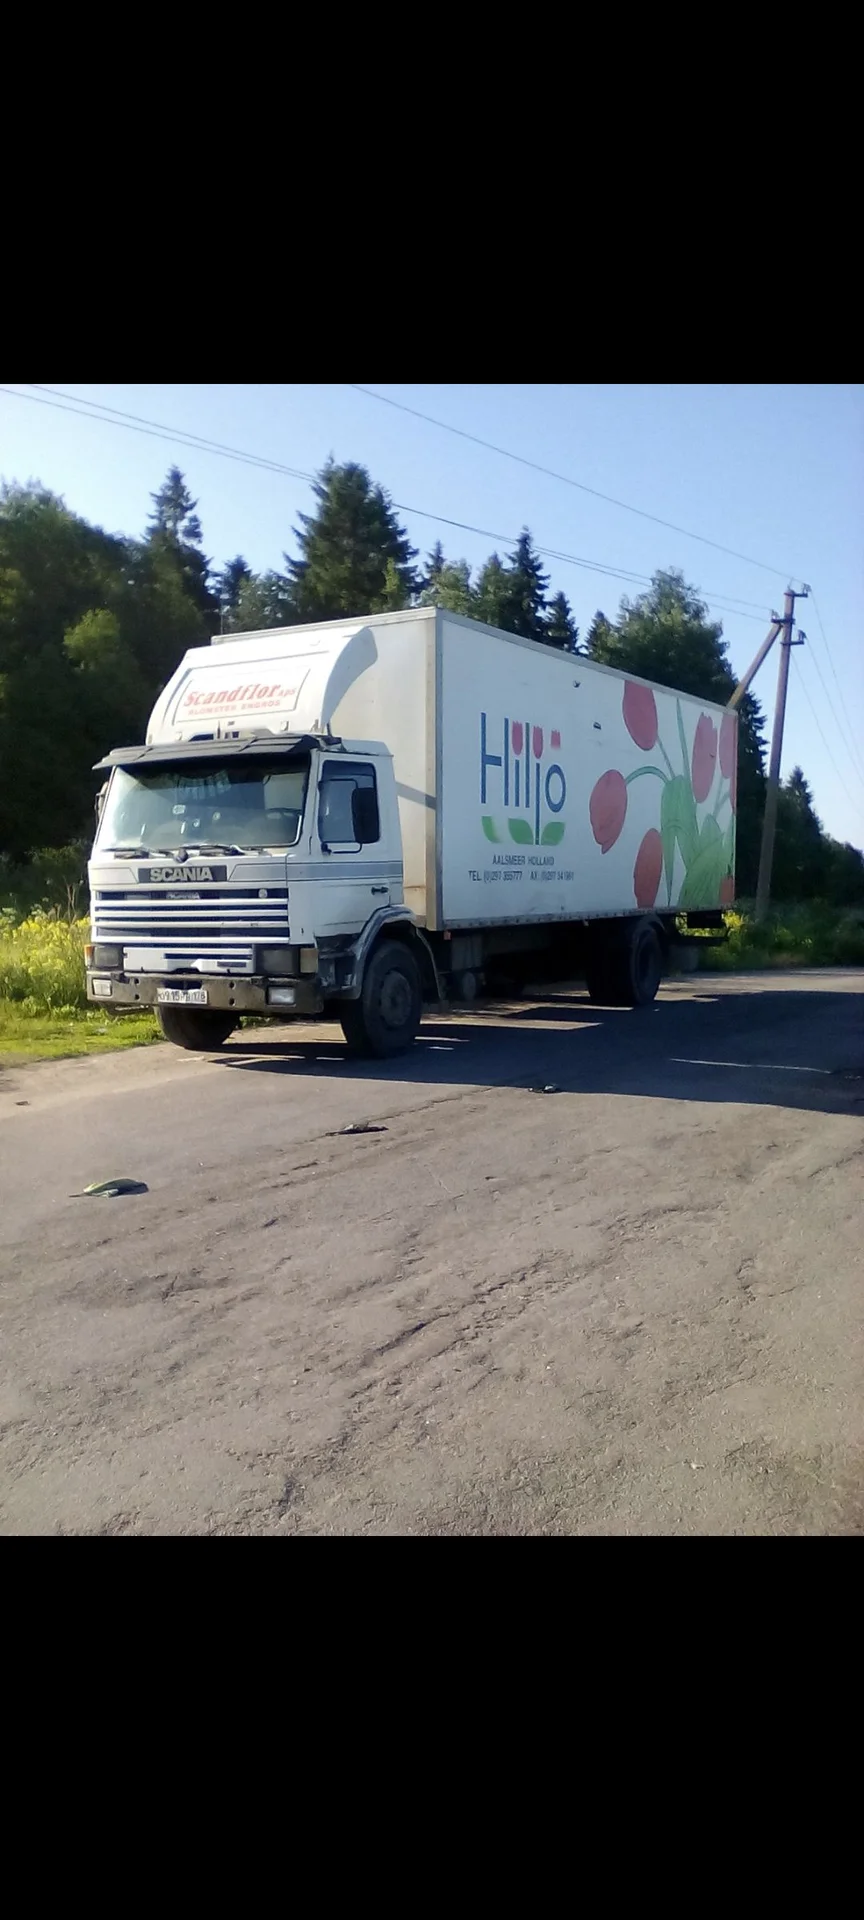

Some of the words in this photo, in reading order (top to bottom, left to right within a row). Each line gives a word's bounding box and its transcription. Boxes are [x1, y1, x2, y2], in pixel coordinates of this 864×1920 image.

[184, 684, 281, 706] Scandflor
[492, 854, 526, 866] AALSMEER
[527, 855, 555, 866] HOLLAND
[150, 866, 213, 882] SCANIA
